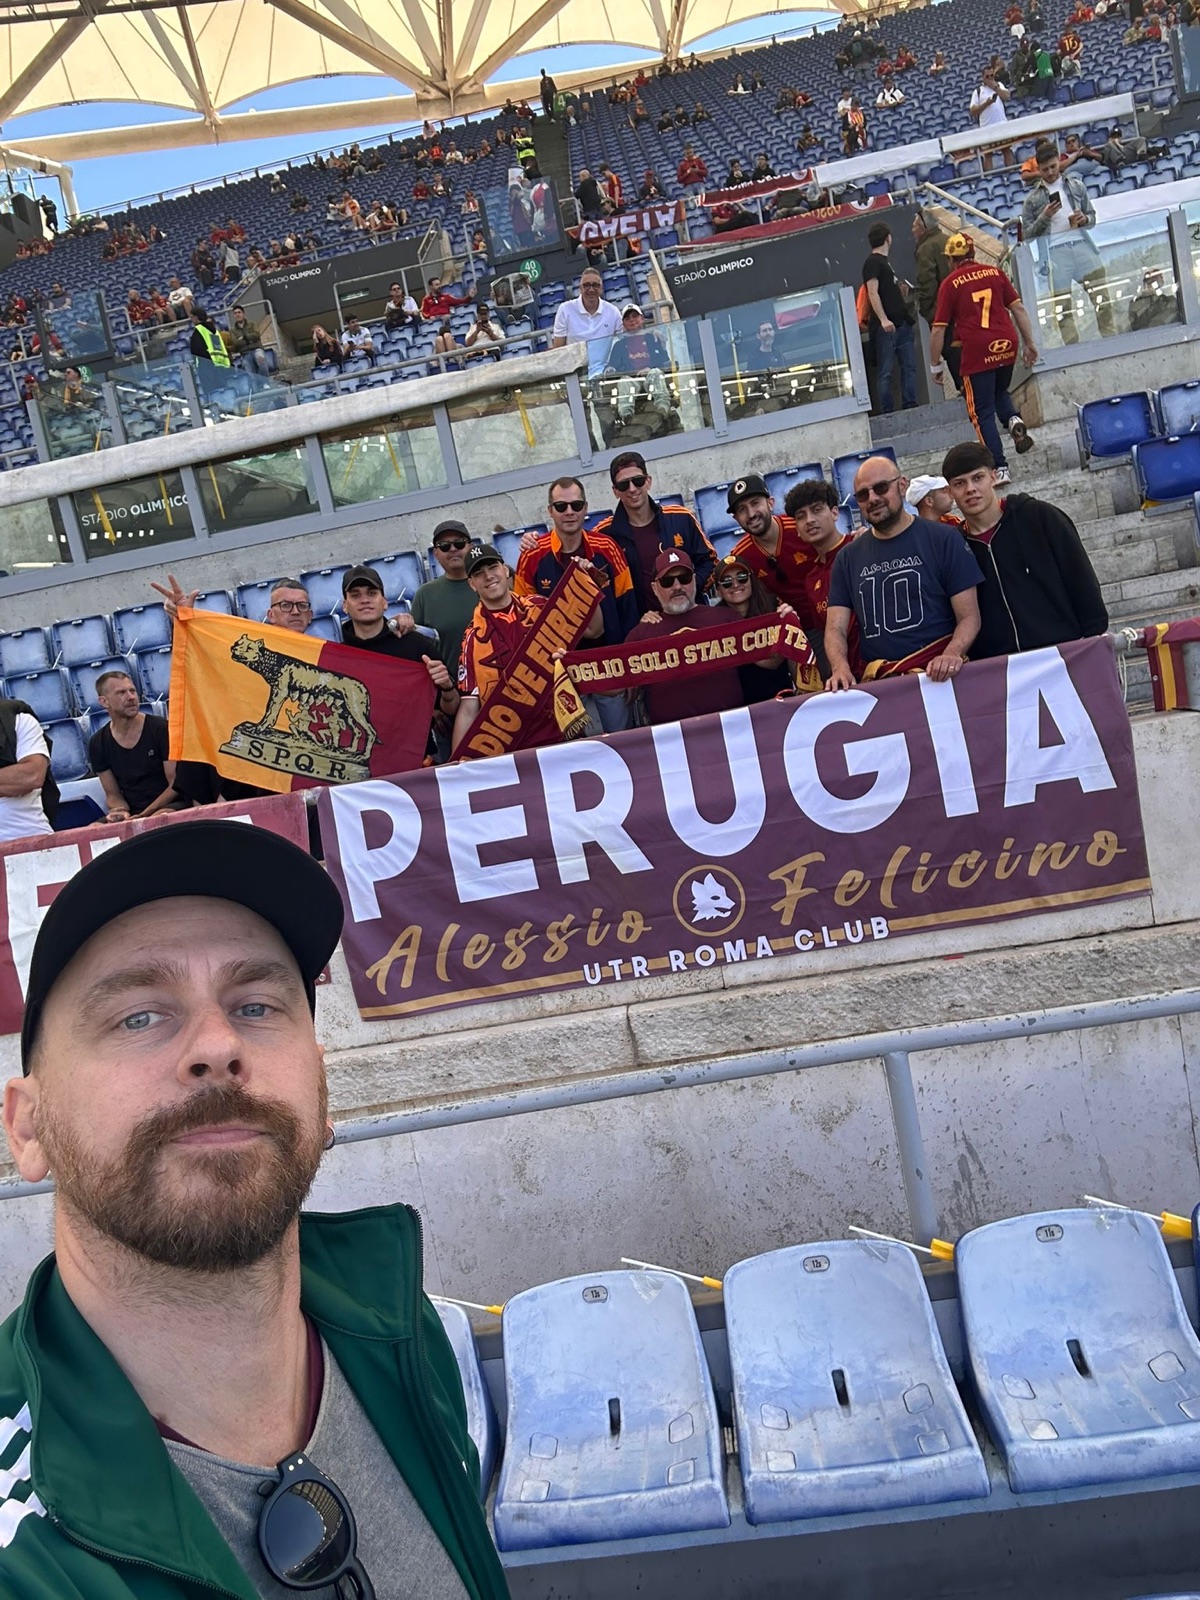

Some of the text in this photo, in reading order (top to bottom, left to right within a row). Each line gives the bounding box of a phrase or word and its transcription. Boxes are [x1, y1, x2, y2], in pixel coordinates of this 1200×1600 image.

[266, 267, 321, 287] STADIO OLIMPICO
[525, 260, 536, 271] 40
[674, 257, 754, 285] STADIO OLIMPICO
[952, 268, 1000, 289] PELLEGRINI
[971, 288, 993, 329] 7
[859, 569, 924, 639] 10
[567, 623, 808, 684] OGLIO SOLO STAR CON TE
[468, 704, 522, 757] DIO
[501, 661, 548, 708] VE
[329, 646, 1118, 923] PERUGIA
[365, 907, 652, 996] Alessio
[768, 829, 1128, 926] Felicino
[583, 916, 890, 985] UTR ROMA CLUB
